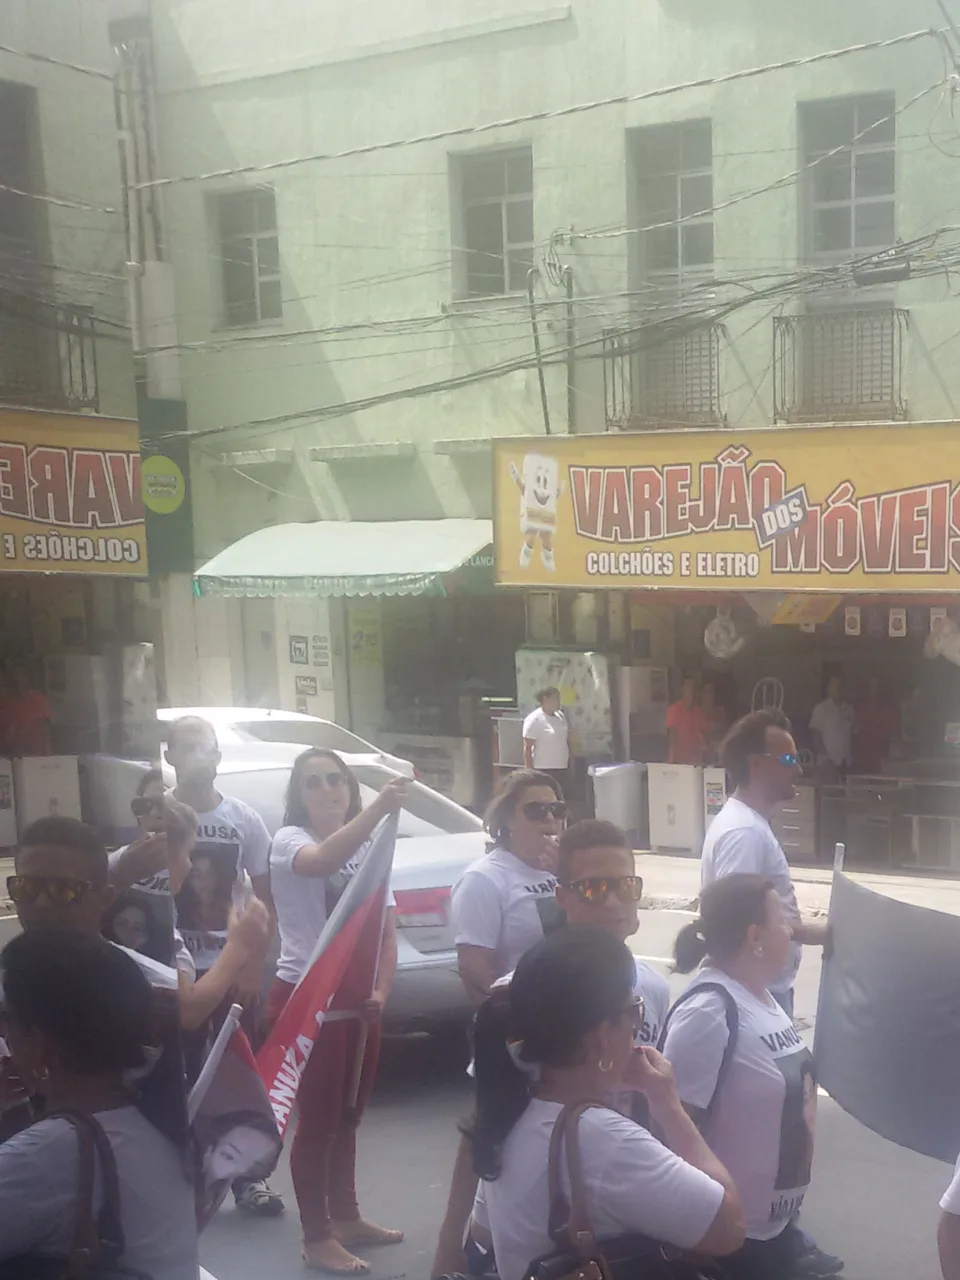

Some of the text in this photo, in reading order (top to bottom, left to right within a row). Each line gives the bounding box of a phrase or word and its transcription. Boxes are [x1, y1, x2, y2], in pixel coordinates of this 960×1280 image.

[568, 444, 788, 550] VAREJÃO
[762, 498, 805, 537] DOS
[586, 546, 761, 577] COLCHÕES E ELETRO
